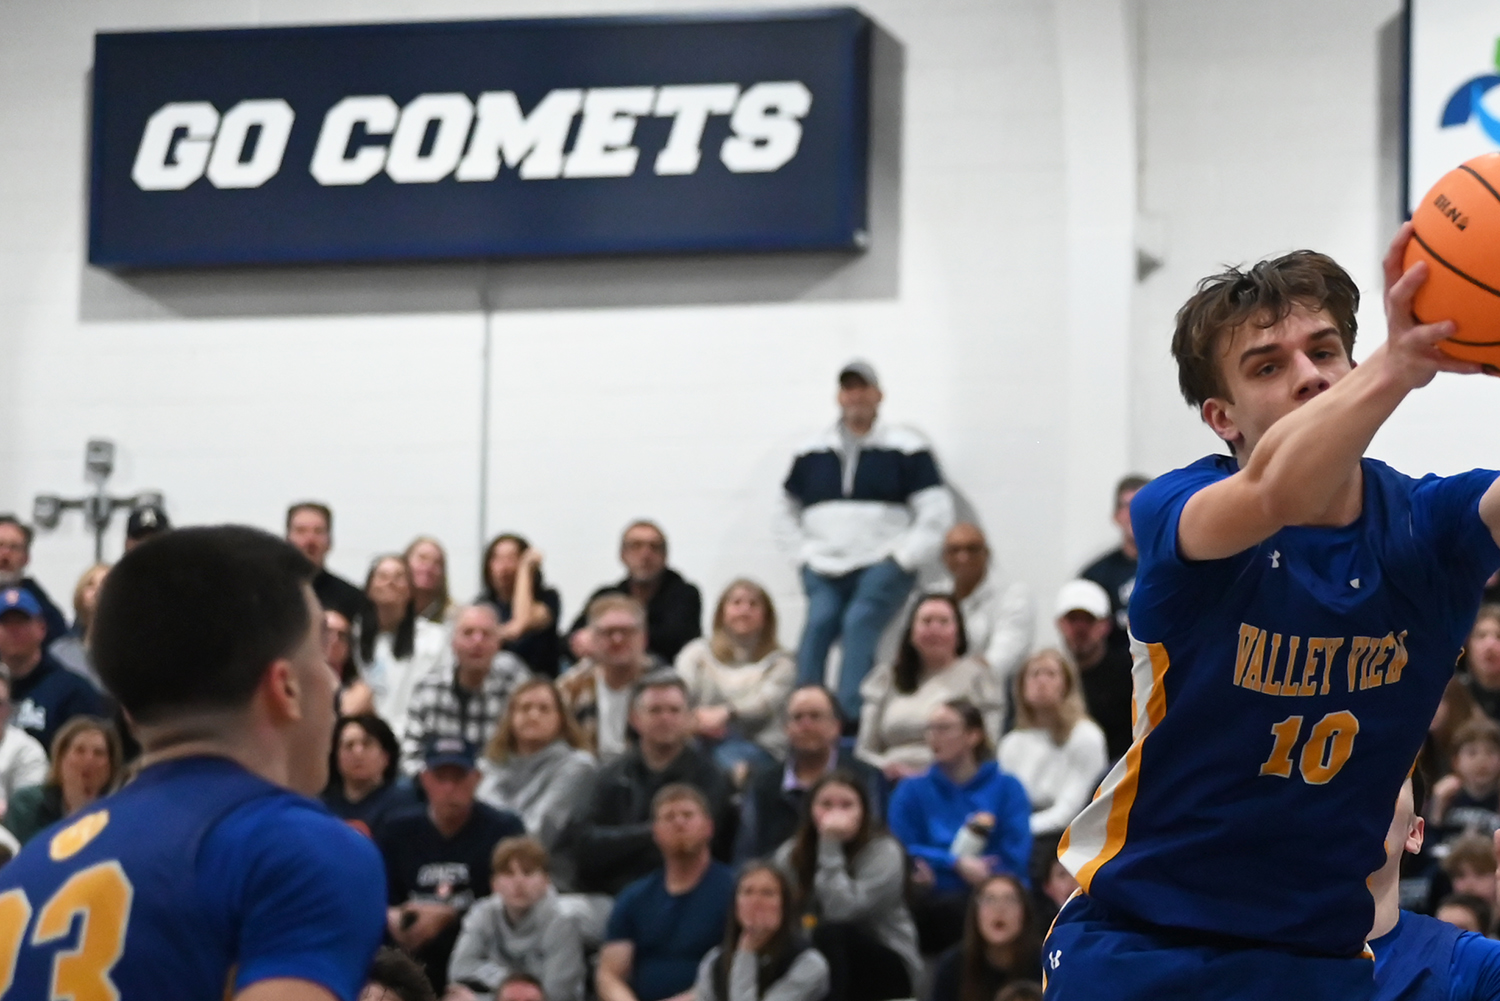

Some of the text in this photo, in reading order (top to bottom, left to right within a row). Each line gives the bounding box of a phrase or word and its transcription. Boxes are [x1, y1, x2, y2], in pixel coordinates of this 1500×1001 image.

[131, 81, 813, 190] GO COMETS
[1233, 622, 1408, 696] VALLEY VIEW
[1258, 710, 1359, 784] 10
